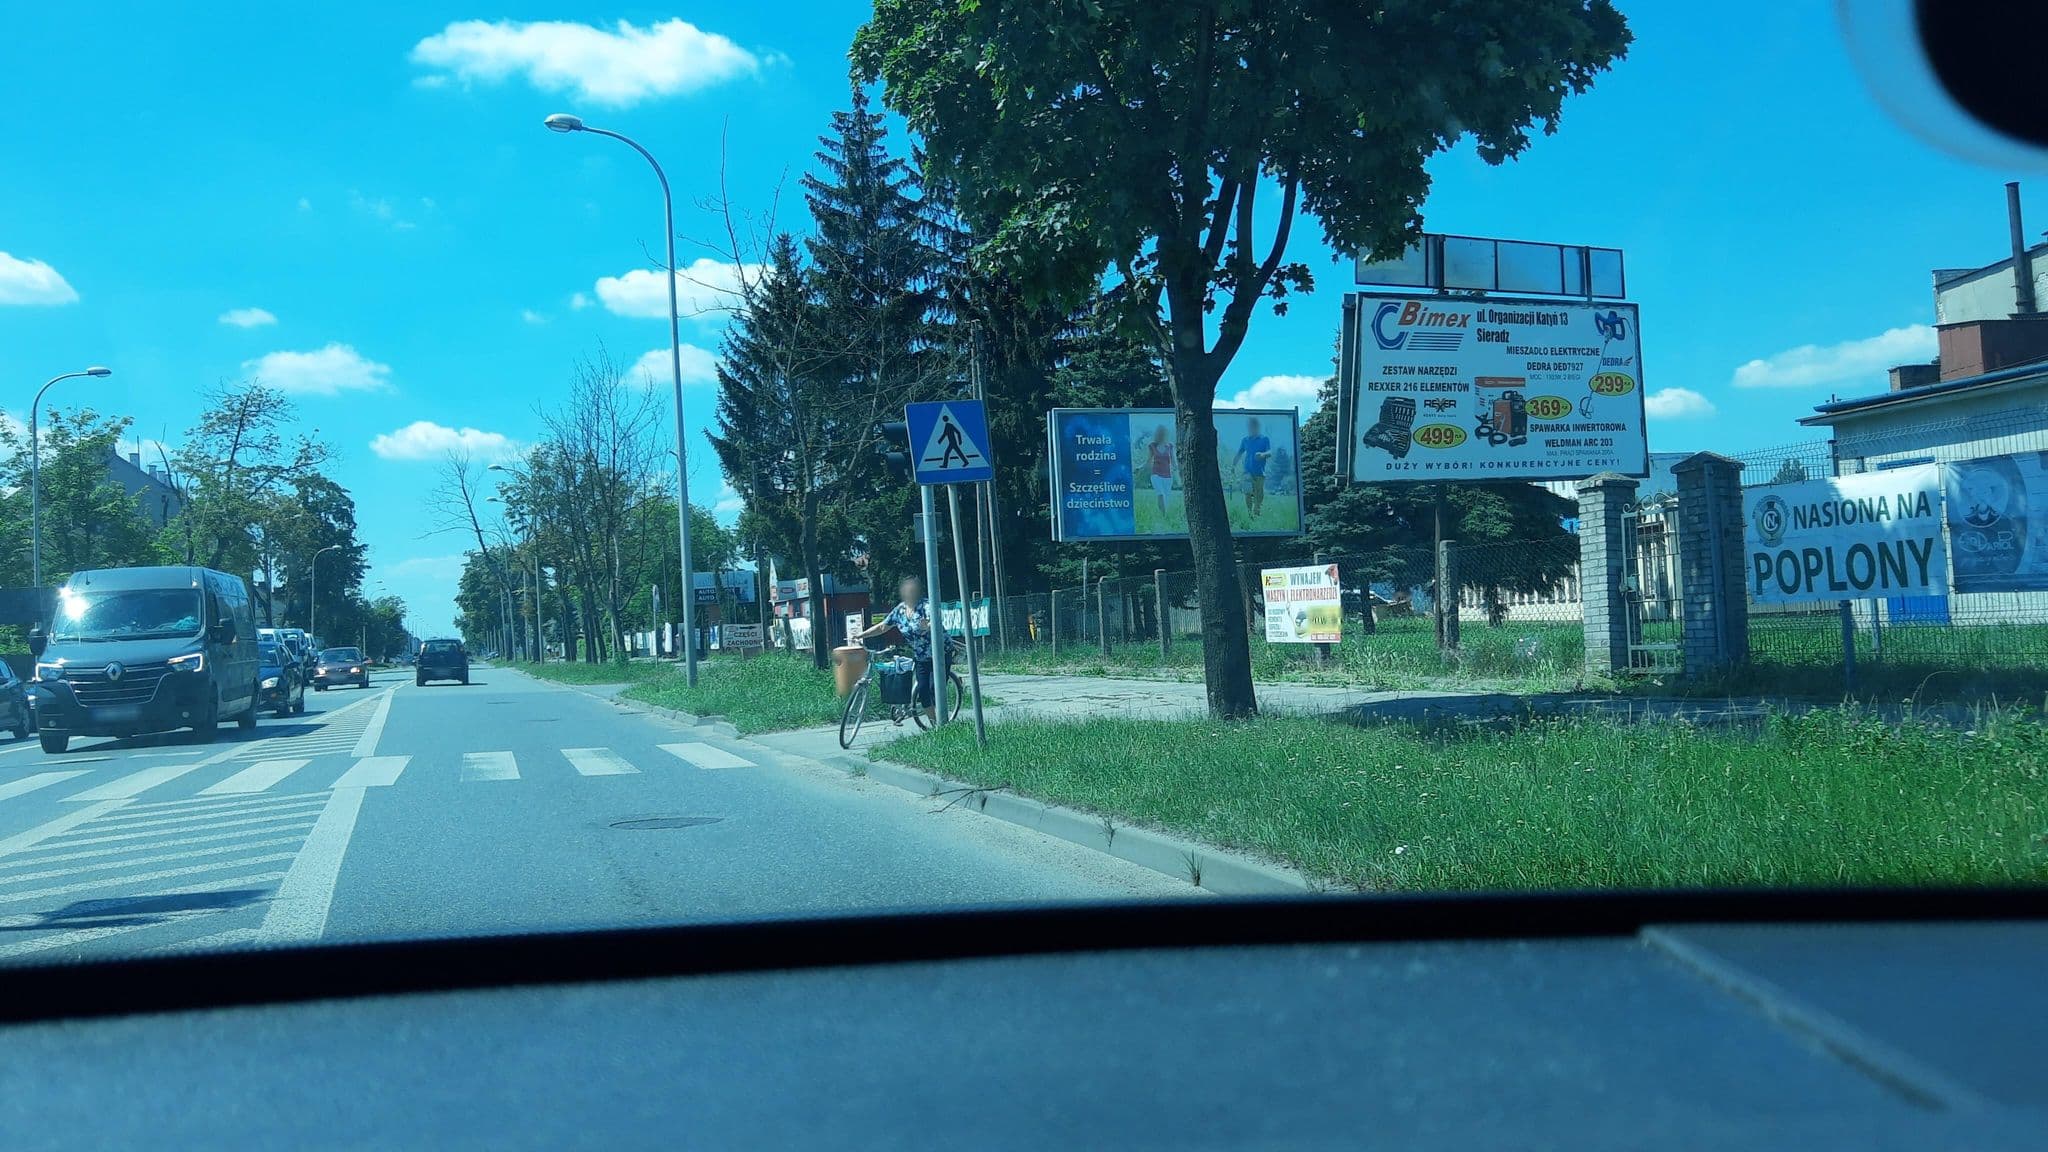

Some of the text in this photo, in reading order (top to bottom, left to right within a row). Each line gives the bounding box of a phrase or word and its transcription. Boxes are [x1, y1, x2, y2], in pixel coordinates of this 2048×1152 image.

[1399, 301, 1471, 328] Bimex
[1488, 309, 1534, 328] Organizacji
[1534, 310, 1559, 328] Katyń
[1559, 311, 1569, 326] 13
[1476, 327, 1510, 344] Sieradz
[1550, 346, 1600, 357] ELEKTRYCZNE
[1526, 361, 1551, 371] DEDRA
[1602, 357, 1624, 367] DEDRA
[1382, 365, 1457, 378] ZESTAW NARZĘDZI
[1368, 381, 1401, 392] REXXER
[1402, 381, 1417, 392] 216
[1594, 375, 1624, 393] 299
[1530, 398, 1561, 417] 369
[1529, 422, 1627, 433] SPAWARKA INWERTOROWA
[1075, 433, 1112, 446] Trwała
[1420, 427, 1454, 445] 499
[1544, 438, 1613, 448] WELDMAN ARC 203
[1076, 449, 1117, 461] rodzina
[1386, 460, 1418, 471] DUŻY
[1480, 459, 1581, 470] KONKURENCYJNE
[1587, 458, 1621, 467] CENY!
[1069, 482, 1126, 495] Szczęśliwe
[1066, 498, 1130, 510] dzieciństwo
[1793, 495, 1891, 530] NASIONA
[1897, 491, 1932, 519] NA
[1753, 537, 1934, 596] POPLONY
